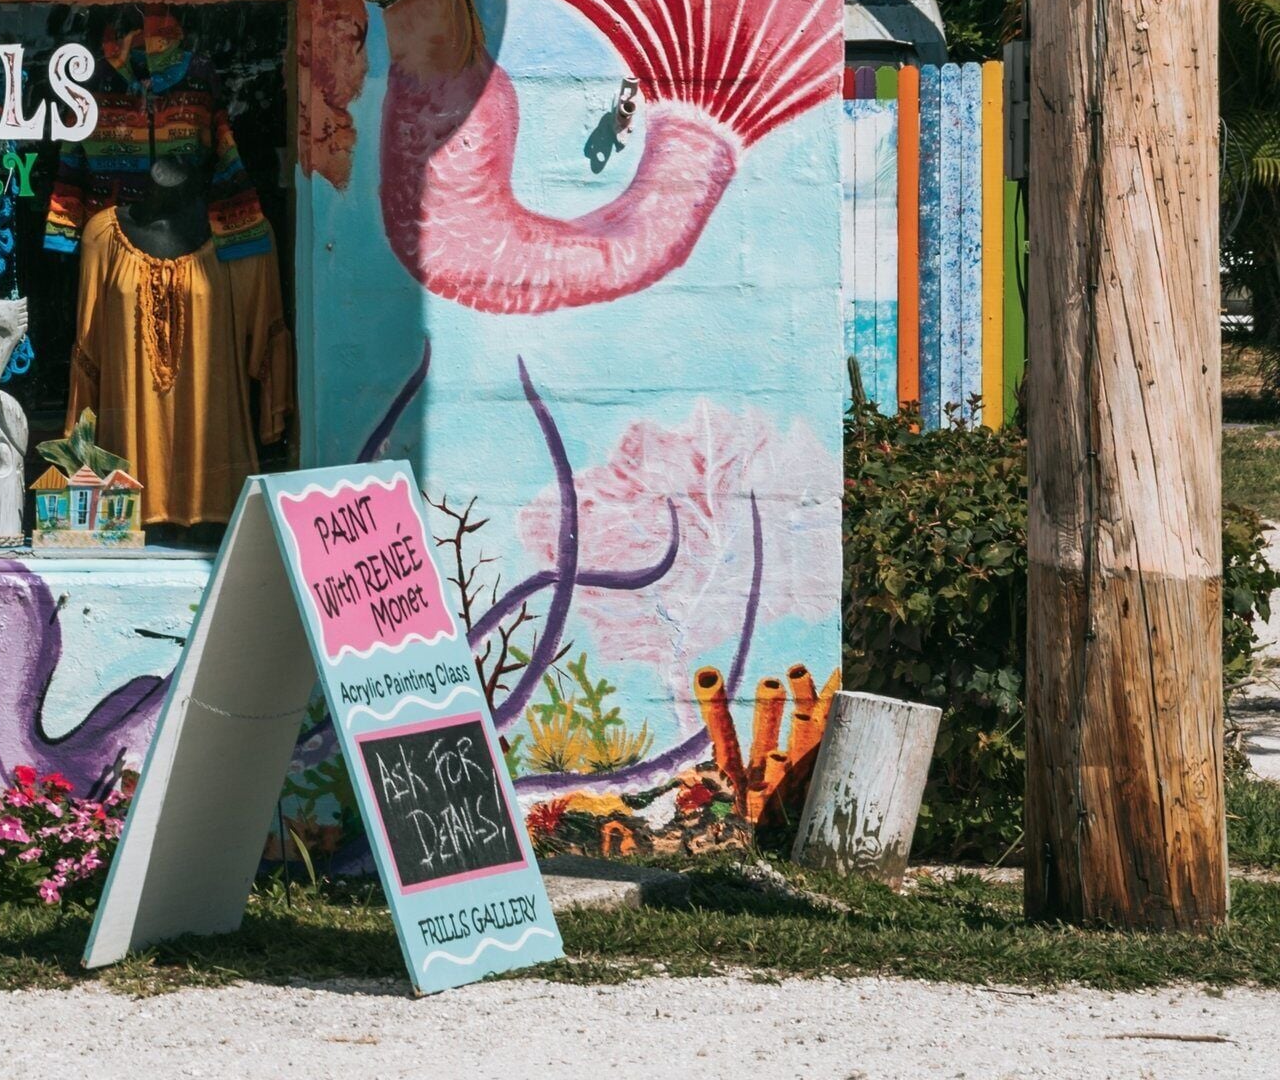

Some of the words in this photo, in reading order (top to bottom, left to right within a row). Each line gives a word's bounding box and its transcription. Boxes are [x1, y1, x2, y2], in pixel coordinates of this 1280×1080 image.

[314, 496, 377, 555] PAINT
[313, 570, 362, 619] With
[354, 522, 423, 598] RENÉE
[370, 583, 429, 637] Monet
[341, 677, 386, 707] Acrylic
[383, 669, 437, 696] Painting
[434, 661, 471, 687] Class
[418, 909, 471, 946] FRILLS
[471, 894, 538, 935] GALLERY
